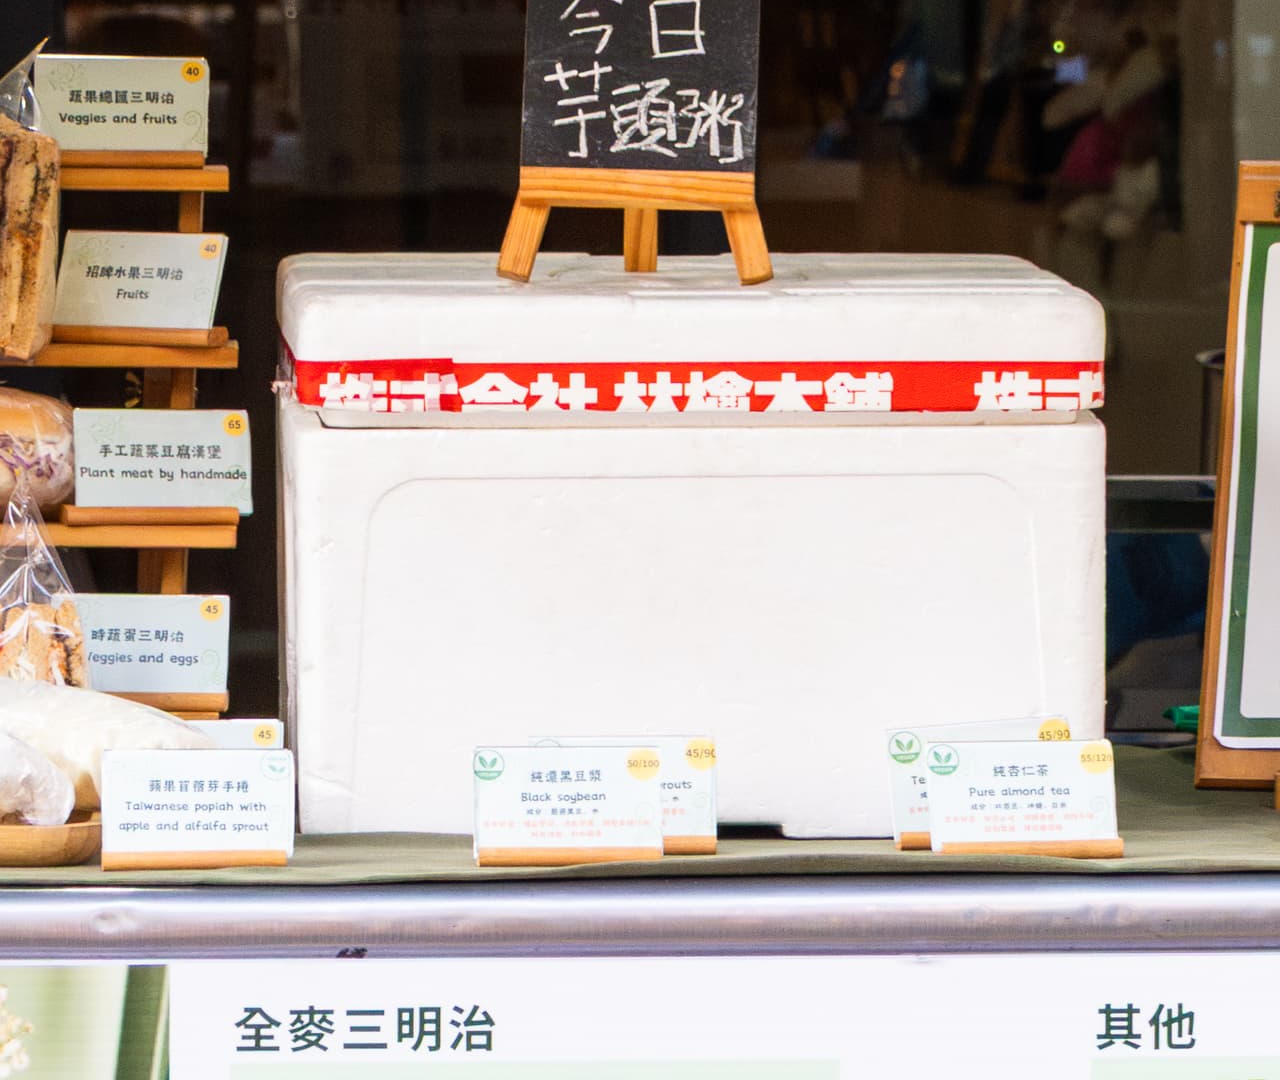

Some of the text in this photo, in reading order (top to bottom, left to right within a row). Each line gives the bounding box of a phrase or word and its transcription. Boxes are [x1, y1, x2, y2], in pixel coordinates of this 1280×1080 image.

[185, 67, 200, 77] 40
[543, 60, 745, 164] 芋頭粥
[58, 113, 107, 126] Veggies
[113, 113, 137, 124] and
[204, 244, 217, 254] 40
[85, 265, 184, 281] 招牌水果三明治
[116, 289, 149, 300] Fruits
[227, 419, 241, 429] 65
[99, 444, 222, 460] 手工蔬菜豆腐漢堡
[80, 466, 247, 481] Plant meat by handmade
[205, 605, 218, 614] 45
[91, 628, 184, 643] 時蔬蛋三明治
[138, 652, 163, 663] and
[170, 655, 199, 667] eggs
[257, 730, 272, 740] 45
[993, 764, 1049, 778] 純杏仁茶
[521, 792, 606, 804] Black soybean
[969, 786, 1071, 797] Pure almond tea
[125, 800, 266, 813] Taiwanese popiah with
[119, 820, 269, 833] apple and alfalfa sprout
[234, 1005, 496, 1052] 全麥三明治
[1096, 1003, 1196, 1050] 其他
